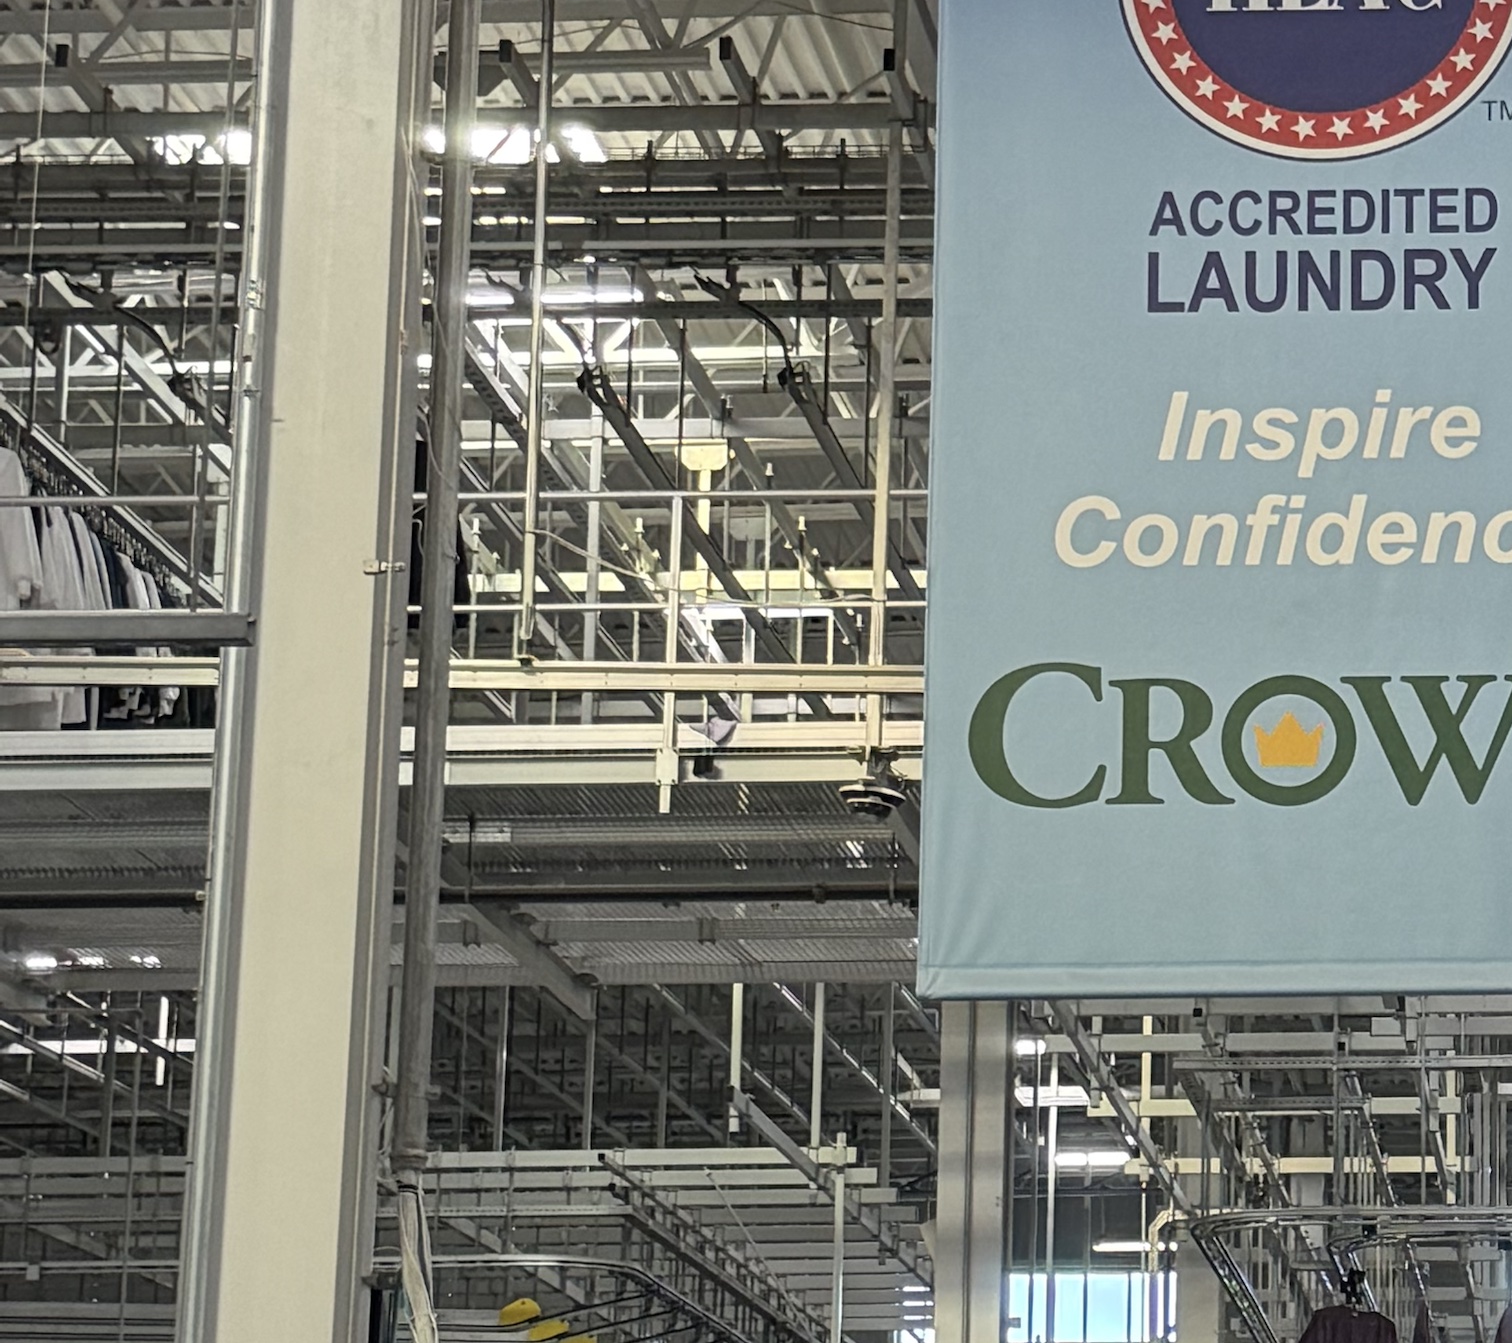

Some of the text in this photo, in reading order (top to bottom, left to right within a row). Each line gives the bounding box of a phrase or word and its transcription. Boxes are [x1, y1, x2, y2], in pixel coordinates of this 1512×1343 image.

[1148, 187, 1499, 237] ACCREDITED
[1146, 247, 1498, 314] LAUNDRY
[1157, 388, 1482, 479] Inspire
